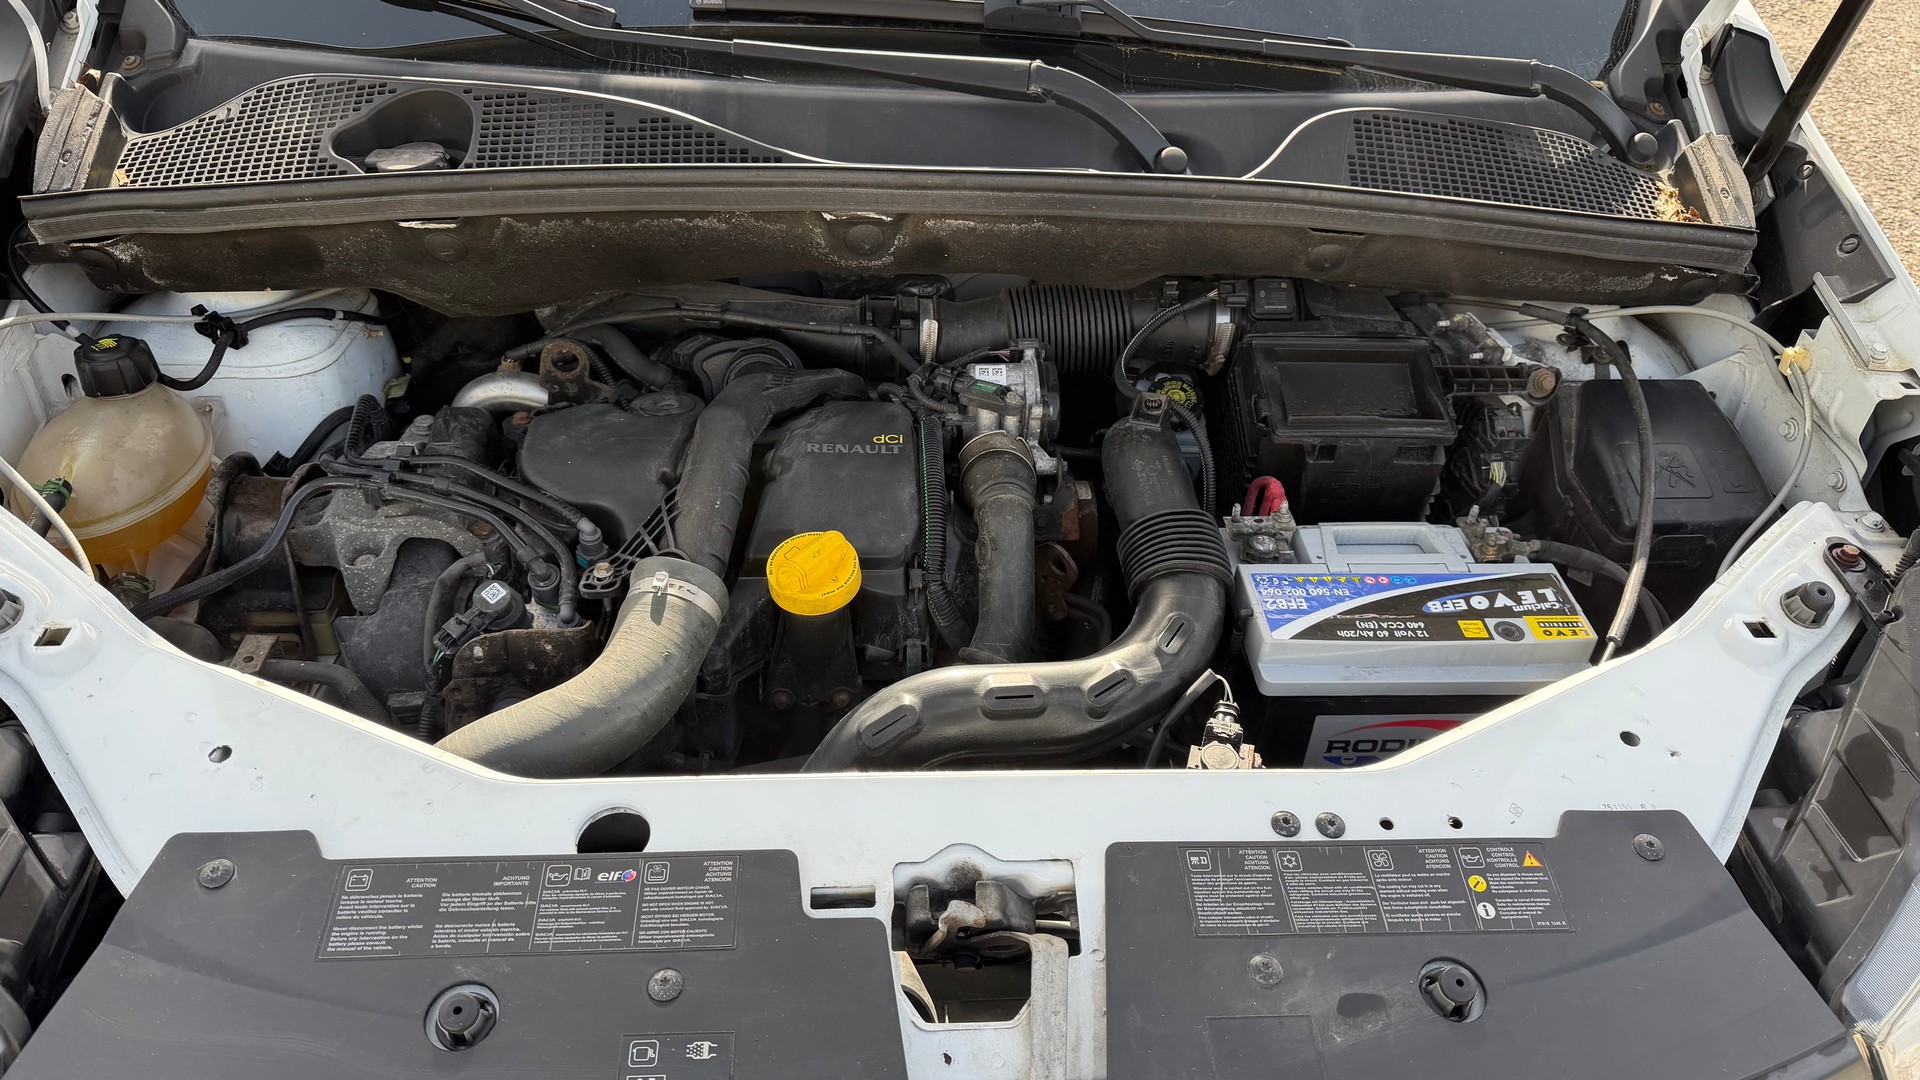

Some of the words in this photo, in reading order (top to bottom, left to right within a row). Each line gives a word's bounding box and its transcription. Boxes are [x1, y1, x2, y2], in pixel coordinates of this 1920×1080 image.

[873, 435, 902, 443] dCi
[807, 443, 902, 454] RENAULT
[1266, 599, 1308, 609] EFB2
[1429, 599, 1468, 612] EFB
[1513, 602, 1559, 611] Calcium
[1356, 621, 1378, 629] (EN)
[597, 871, 622, 881] elf
